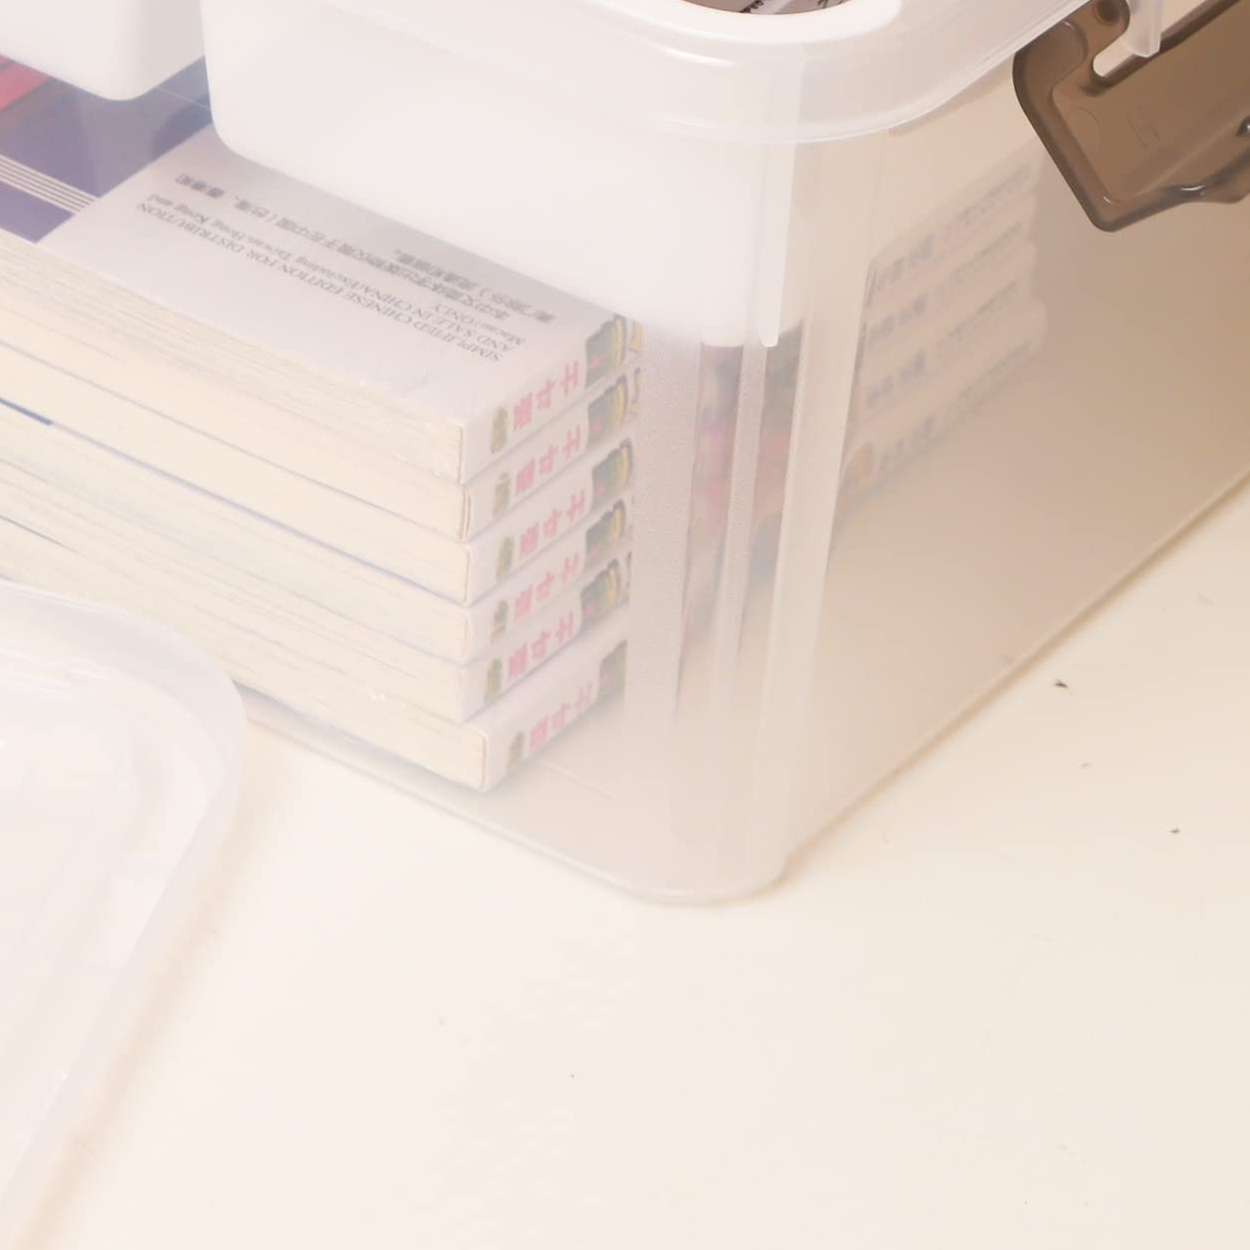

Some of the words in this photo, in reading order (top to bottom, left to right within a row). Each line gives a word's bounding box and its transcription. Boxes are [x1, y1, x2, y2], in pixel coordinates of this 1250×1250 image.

[137, 203, 245, 254] DISTRIBUTION
[247, 250, 279, 268] FOR
[279, 264, 344, 296] EDITION
[348, 291, 413, 324] CHINESE
[413, 320, 504, 363] SIMPLIFIED
[433, 314, 477, 338] SALE
[476, 333, 516, 352] AND
